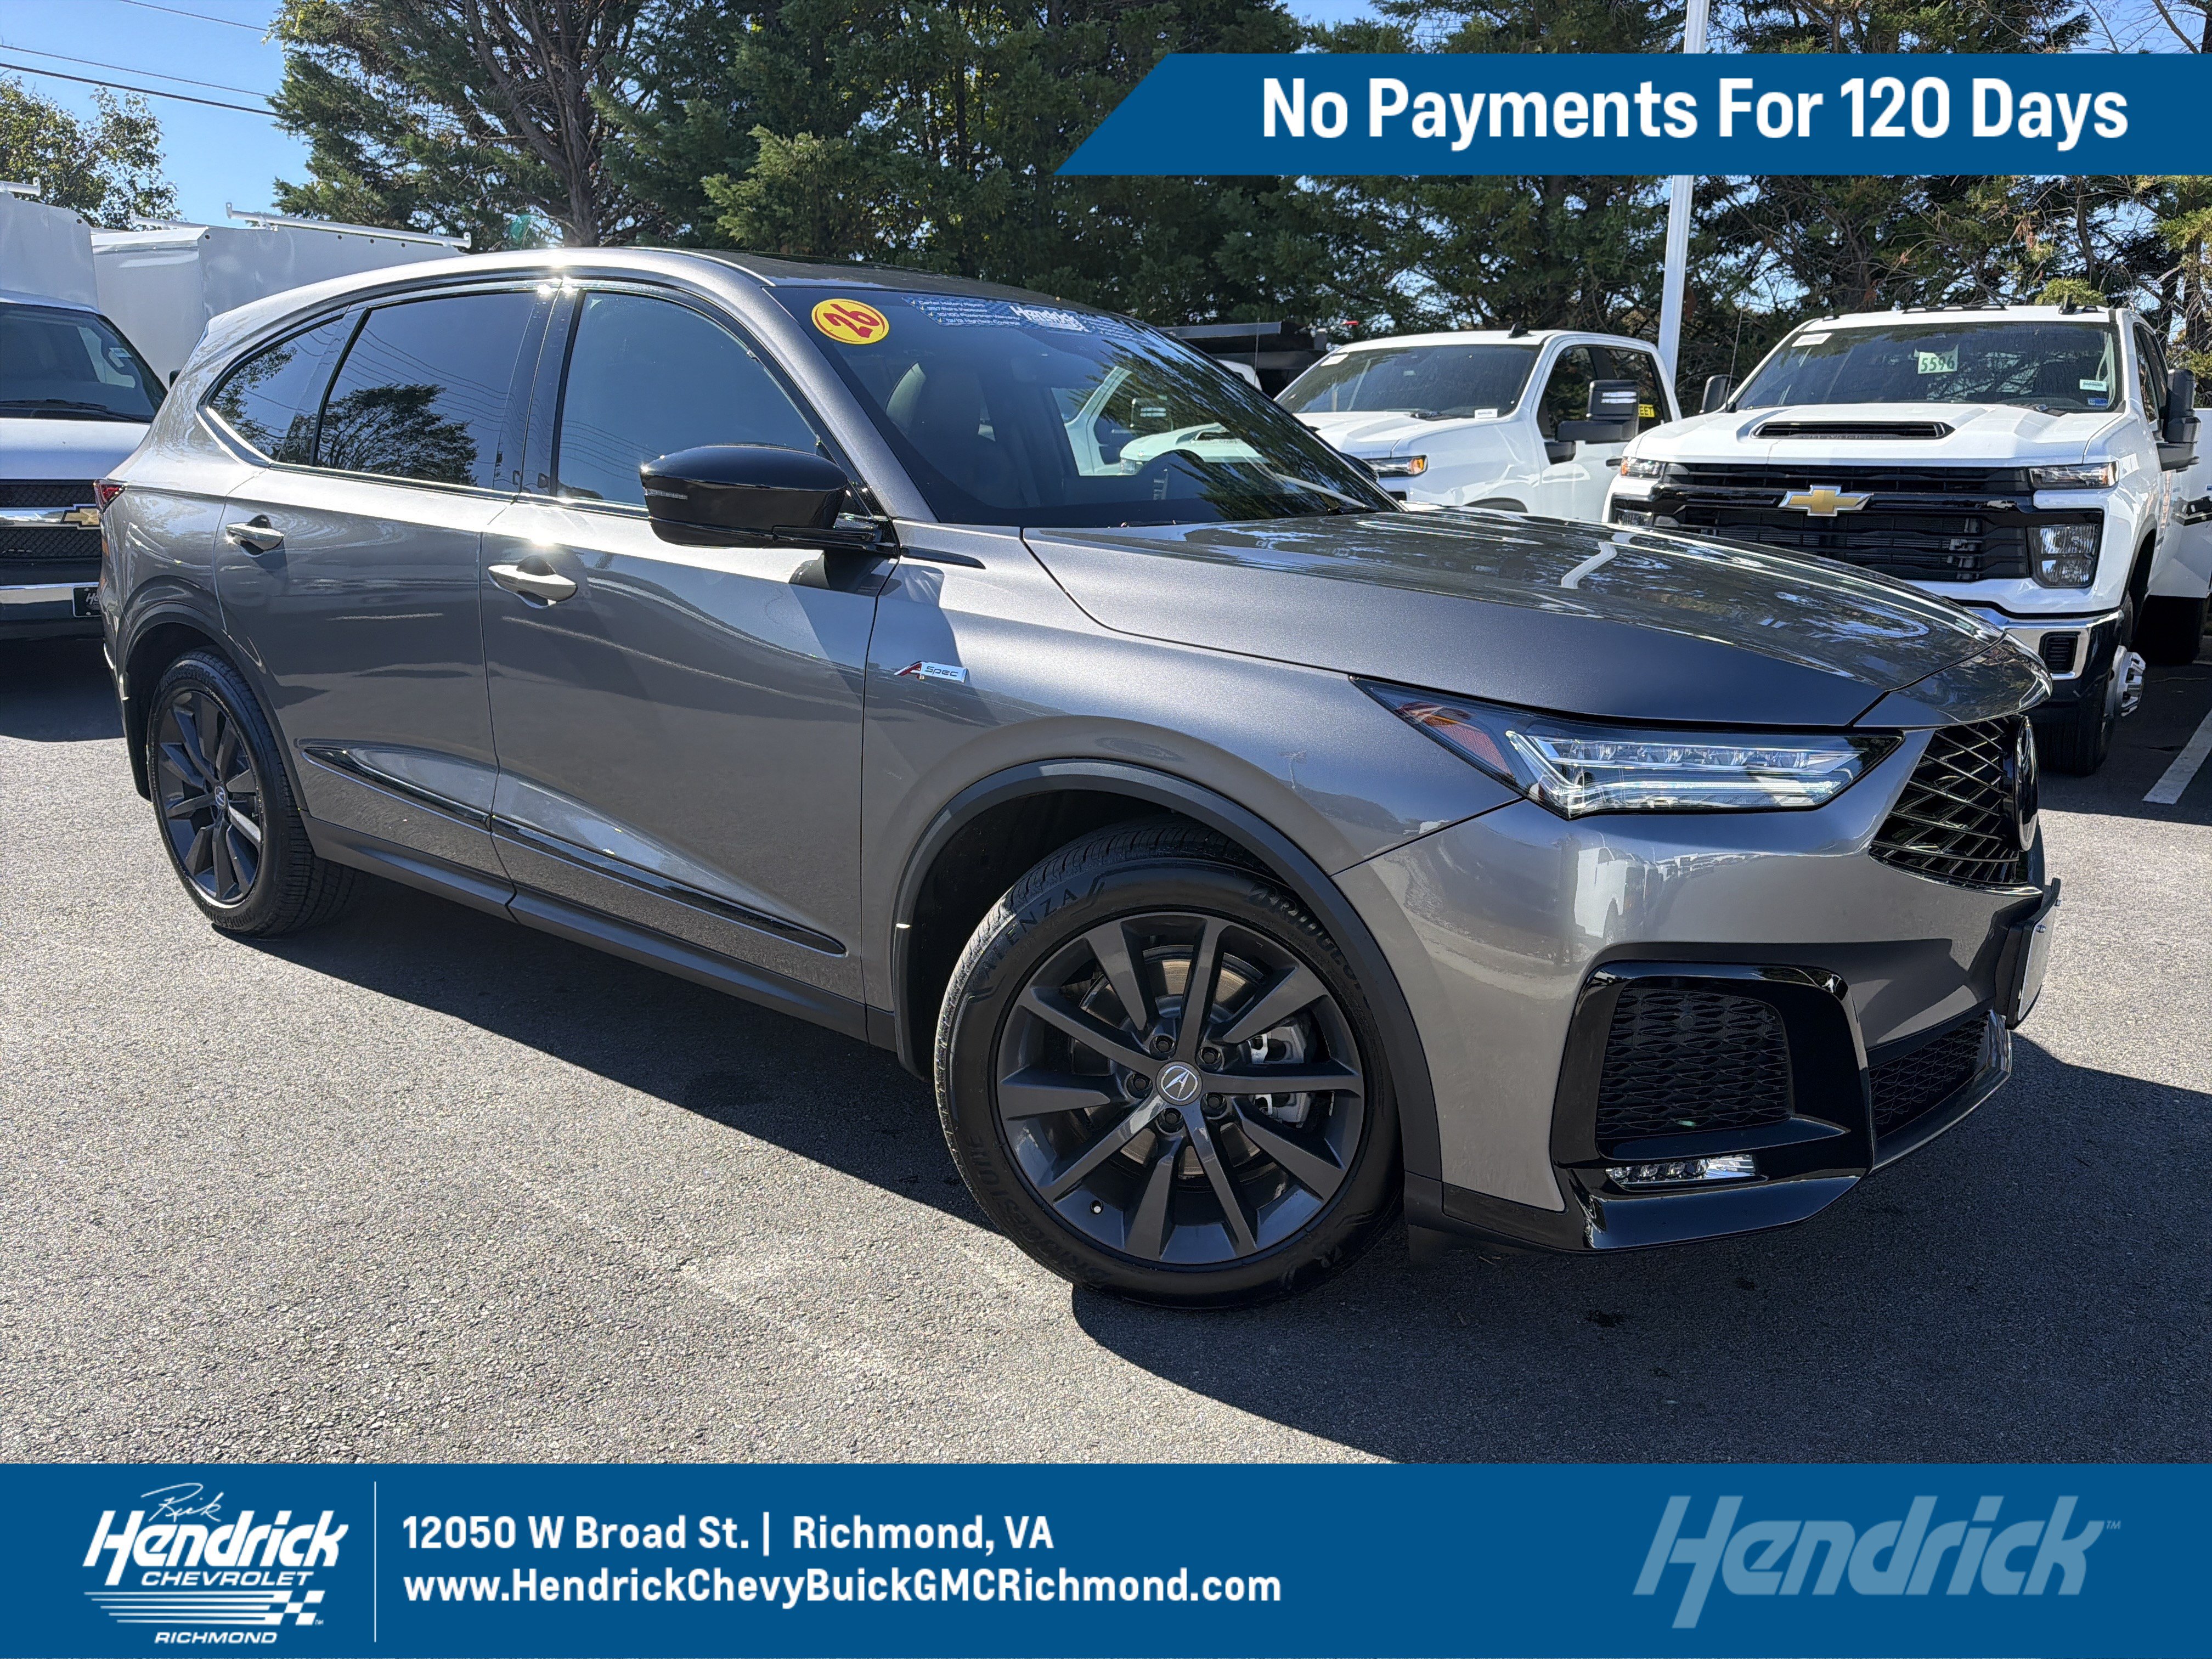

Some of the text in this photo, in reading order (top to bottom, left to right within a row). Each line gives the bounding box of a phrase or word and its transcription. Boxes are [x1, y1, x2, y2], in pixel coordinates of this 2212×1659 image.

[822, 303, 881, 338] 26
[1920, 354, 1956, 372] 5596
[1639, 406, 1653, 416] EET
